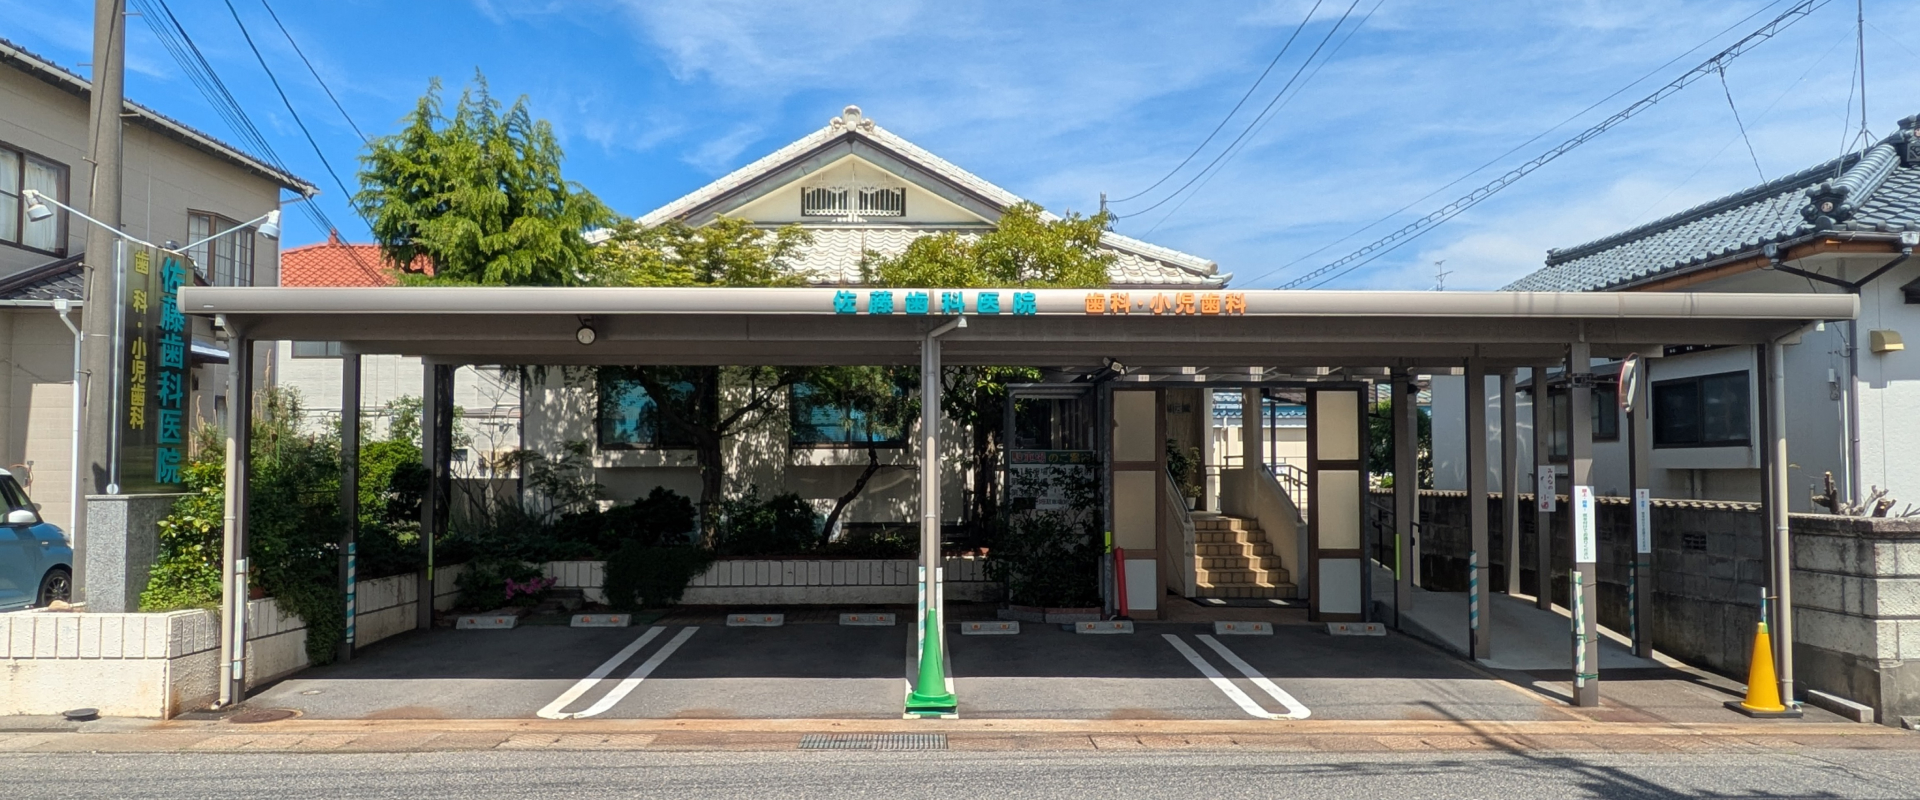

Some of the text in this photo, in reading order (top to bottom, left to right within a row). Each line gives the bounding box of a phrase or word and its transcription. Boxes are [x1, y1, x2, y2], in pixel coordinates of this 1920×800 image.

[130, 250, 150, 430] 歯科・小児歯科
[833, 290, 1037, 315] 佐藤歯科医院
[1085, 292, 1247, 315] 歯科・小児歯科
[156, 257, 186, 484] 佐藤歯科医院
